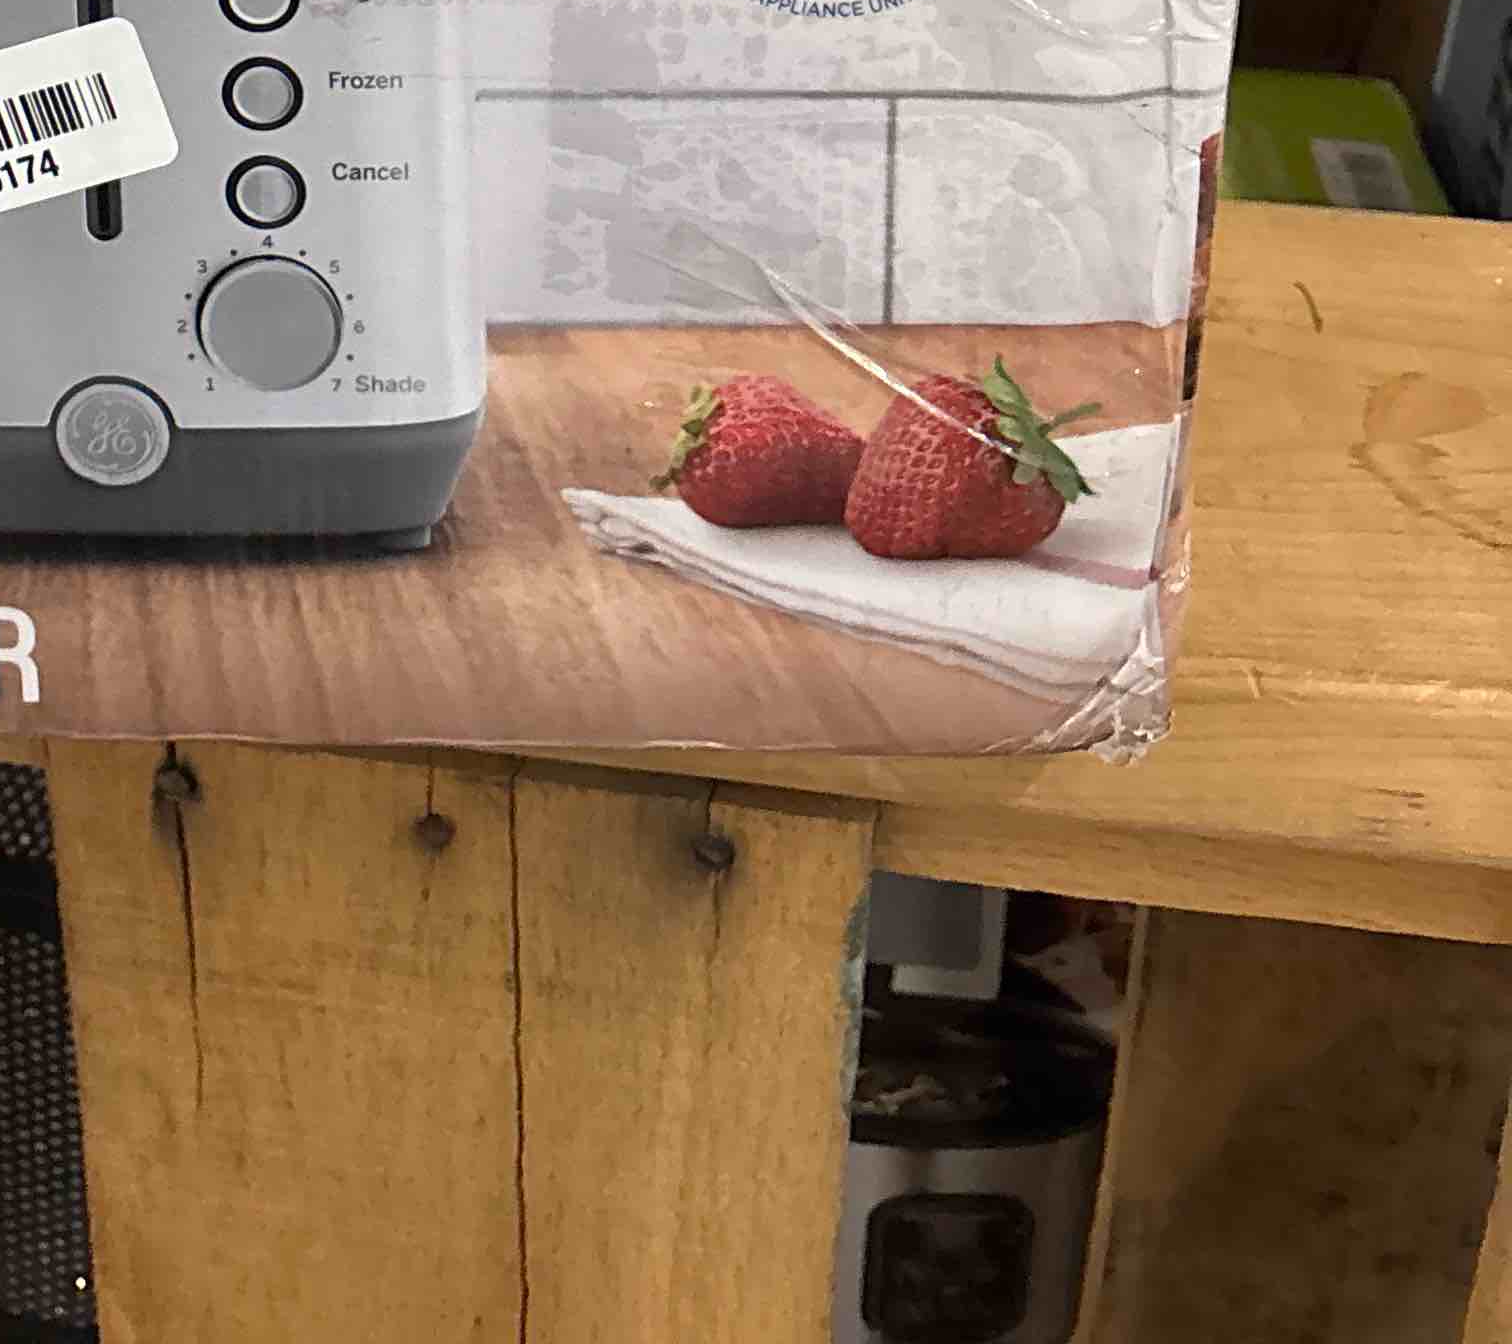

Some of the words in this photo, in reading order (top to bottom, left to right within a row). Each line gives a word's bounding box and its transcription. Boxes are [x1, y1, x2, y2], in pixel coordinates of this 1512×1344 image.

[327, 71, 404, 92] Frozen
[331, 162, 409, 182] Cancel
[261, 234, 275, 250] 4
[196, 259, 209, 275] 3
[329, 259, 341, 275] 5
[177, 319, 189, 334] 2
[353, 320, 366, 335] 6
[204, 377, 216, 392] 1
[330, 377, 343, 393] 7
[354, 375, 427, 394] Shade
